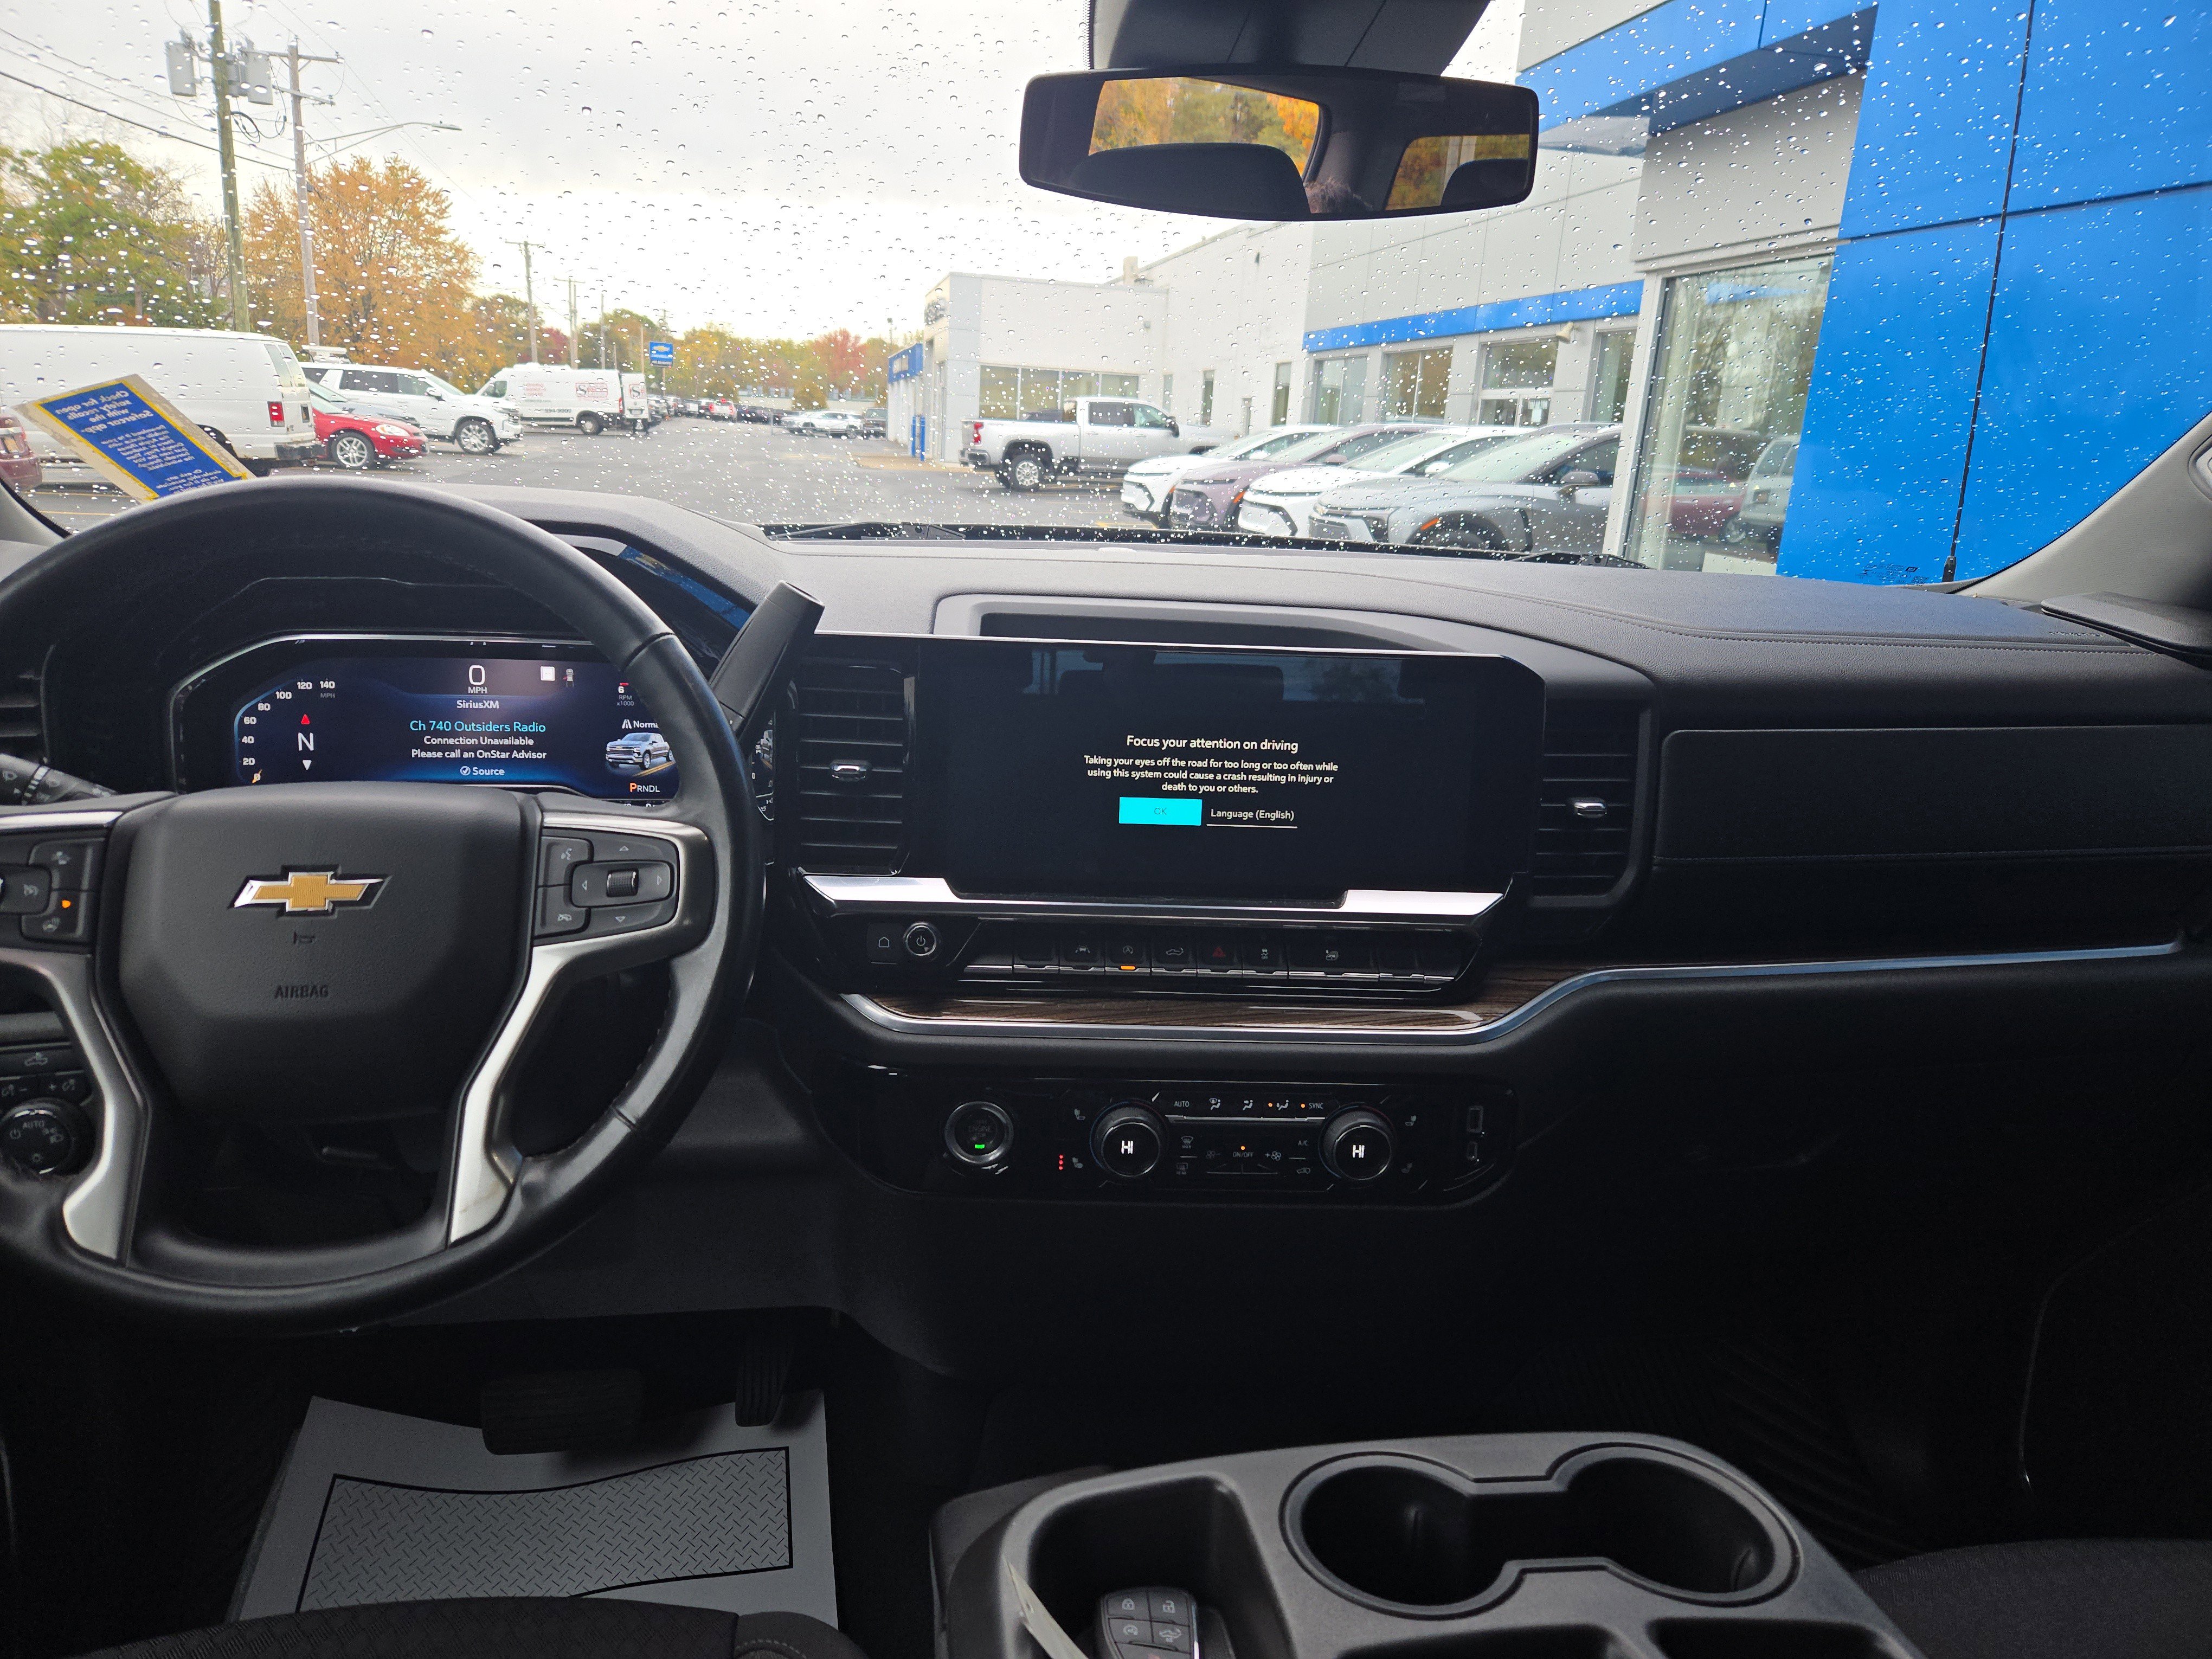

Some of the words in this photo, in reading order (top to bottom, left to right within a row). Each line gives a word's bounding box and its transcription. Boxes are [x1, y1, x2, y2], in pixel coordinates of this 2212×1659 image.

[297, 681, 312, 690] 120
[258, 703, 271, 711] 80
[456, 700, 499, 709] SiriusXM
[410, 720, 426, 731] Ch
[429, 721, 452, 731] 740
[454, 721, 511, 732] Outsiders
[513, 722, 546, 732] Radio
[298, 732, 314, 751] N
[424, 735, 478, 745] Connection
[480, 736, 534, 745] Unavailable
[1127, 735, 1160, 747] Focus
[1161, 738, 1187, 750] your
[1189, 738, 1240, 749] attention
[1243, 741, 1258, 750] on
[1260, 738, 1298, 754] driving
[411, 749, 443, 758] Please
[445, 749, 461, 758] call
[477, 750, 510, 759] OnStar
[512, 750, 547, 759] Advisor
[1084, 755, 1112, 767] Taking
[1113, 758, 1134, 767] your
[1135, 759, 1155, 768] eyes
[1156, 757, 1171, 766] off
[1172, 758, 1186, 767] the
[1187, 758, 1208, 767] road
[1209, 758, 1223, 767] for
[1224, 760, 1239, 768] too
[1241, 760, 1261, 771] long
[1274, 761, 1289, 770] too
[1290, 761, 1314, 770] often
[1315, 762, 1339, 771] while
[472, 767, 505, 775] Source
[1088, 768, 1111, 779] using
[1113, 768, 1129, 777] this
[1131, 771, 1162, 780] system
[1163, 770, 1188, 779] could
[1223, 771, 1247, 781] crash
[1248, 773, 1286, 784] resulting
[1288, 774, 1296, 782] in
[1298, 774, 1322, 785] injury
[1161, 782, 1187, 791] death
[1188, 783, 1198, 792] to
[1199, 785, 1216, 794] you
[1227, 784, 1259, 793] others.
[1154, 807, 1167, 815] OK
[1211, 808, 1254, 820] Language
[1256, 809, 1295, 821] (English)
[273, 984, 329, 998] AIRBAG
[1121, 1140, 1134, 1154] HI
[1352, 1144, 1365, 1158] HI
